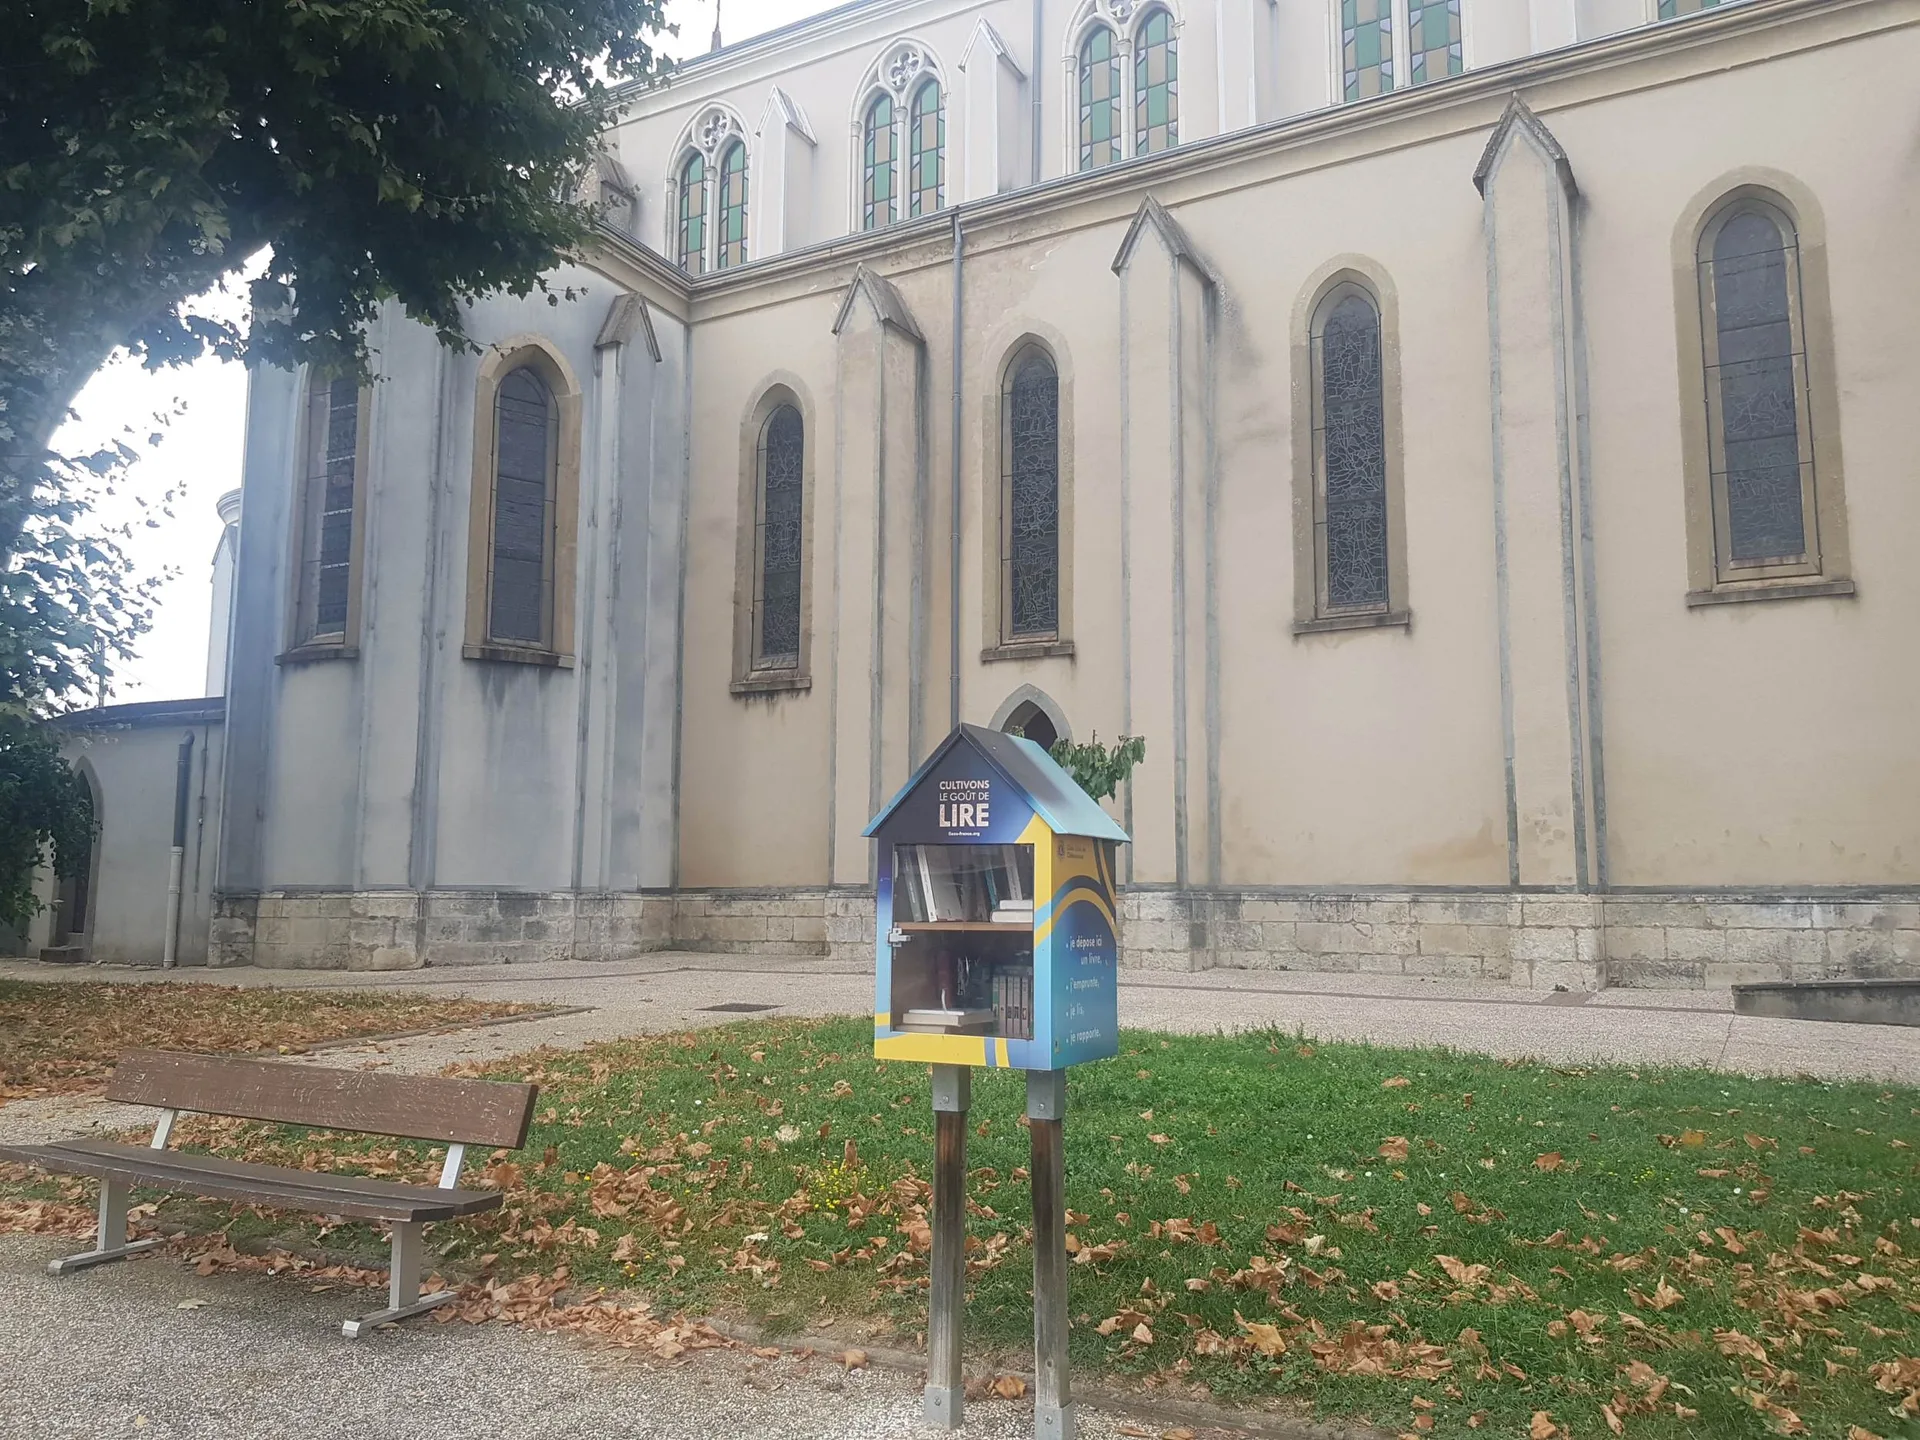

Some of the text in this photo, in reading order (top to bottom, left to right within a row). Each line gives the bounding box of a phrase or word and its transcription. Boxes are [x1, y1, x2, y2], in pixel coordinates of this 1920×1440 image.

[939, 780, 990, 790] CULTIVONS
[939, 790, 990, 801] LE GOÛT DE
[939, 803, 989, 827] LIRE
[1069, 935, 1075, 951] je
[1076, 935, 1095, 951] dépose
